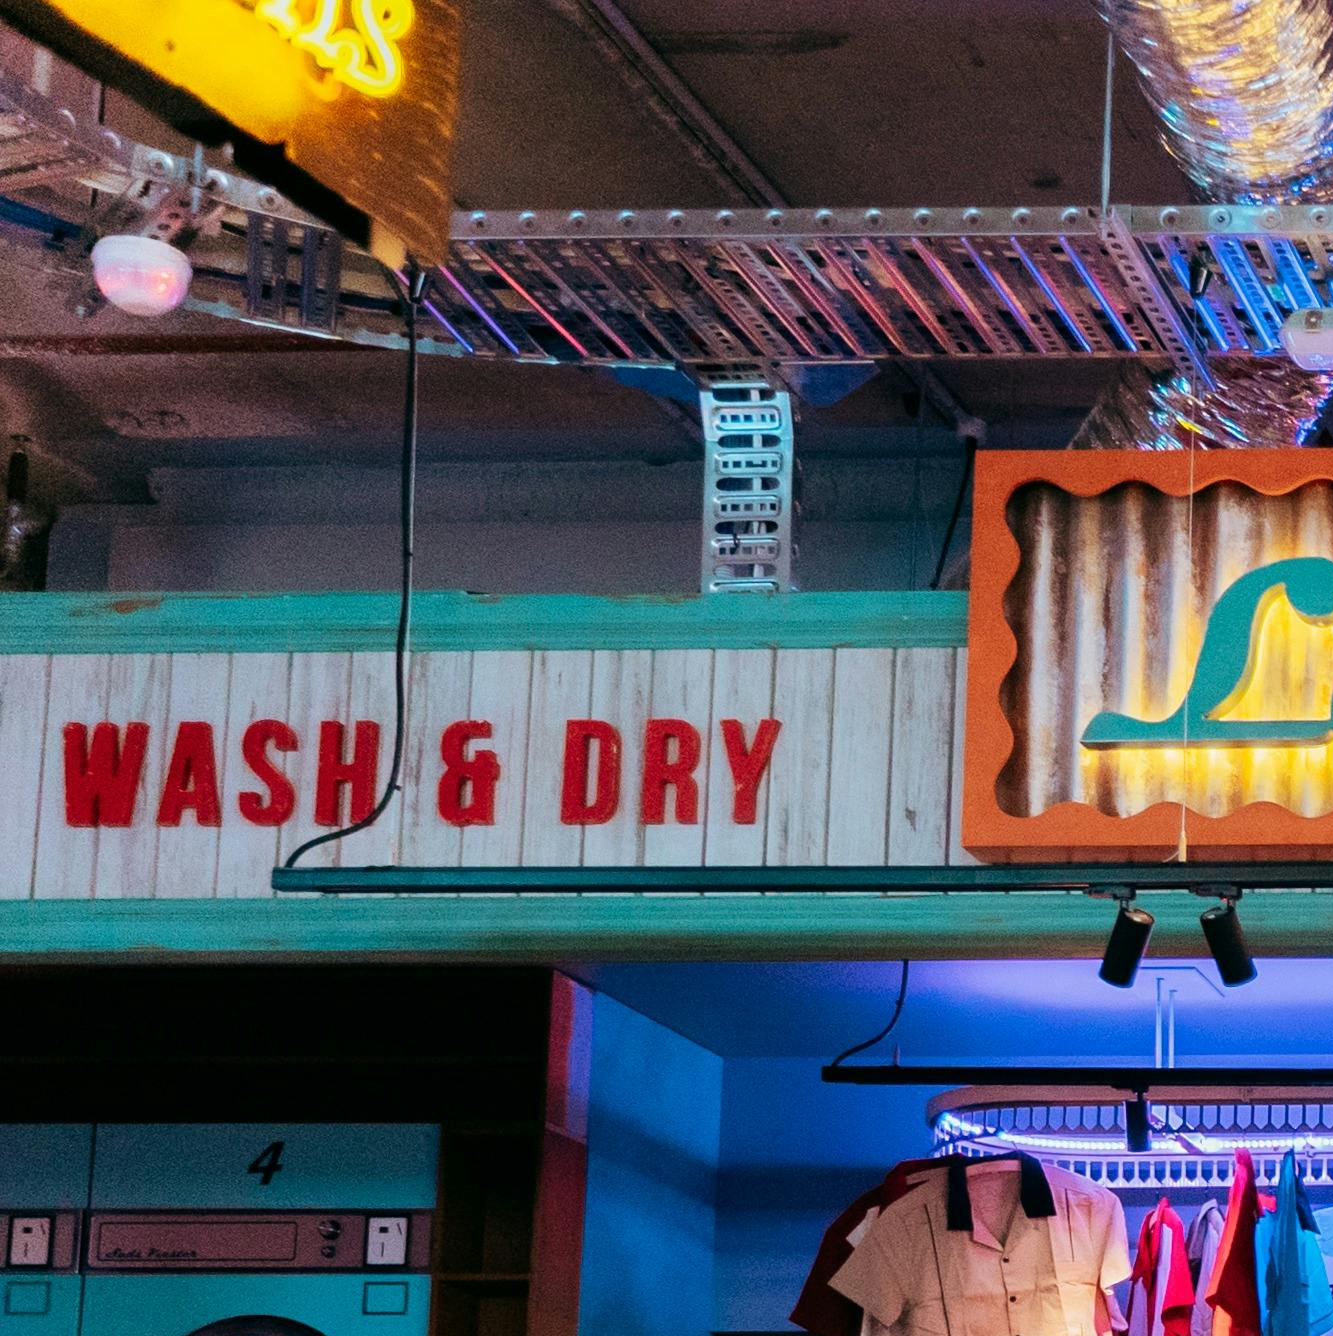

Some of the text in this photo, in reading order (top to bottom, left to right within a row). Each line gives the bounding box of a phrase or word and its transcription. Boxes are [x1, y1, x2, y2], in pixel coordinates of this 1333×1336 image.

[62, 718, 783, 828] WASH & DRY
[247, 1140, 285, 1186] 4
